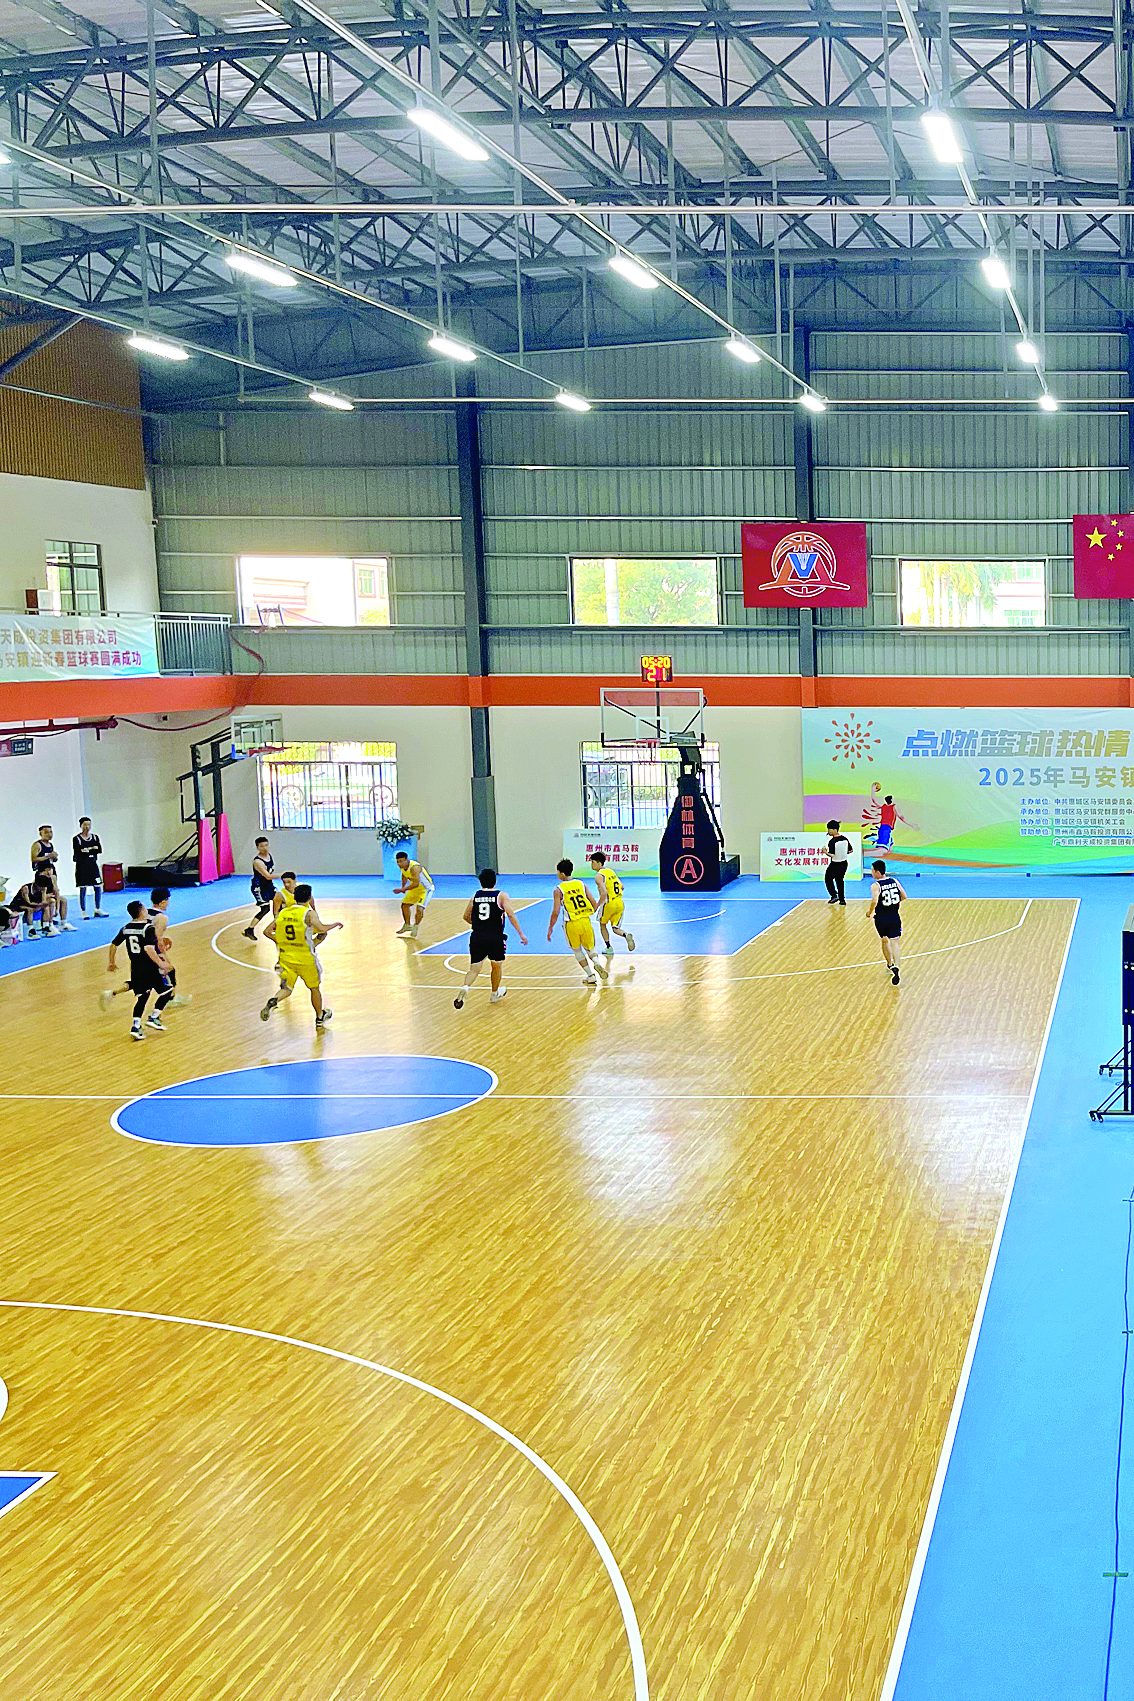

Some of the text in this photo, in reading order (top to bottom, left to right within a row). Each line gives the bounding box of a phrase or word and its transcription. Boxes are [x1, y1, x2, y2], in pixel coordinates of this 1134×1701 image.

[0, 650, 142, 668] 安镇迎新春篮球赛圆满成功
[642, 657, 671, 668] 05:20
[647, 667, 667, 682] 21
[901, 729, 1131, 758] 点燃篮球热情
[585, 844, 640, 853] 惠州市鑫马鞍
[780, 847, 828, 856] 惠州市御林
[585, 853, 640, 863] 投有限公司
[775, 857, 829, 866] 文化发展有限
[680, 858, 698, 879] A
[613, 881, 620, 895] 6
[569, 894, 587, 910] 16
[881, 887, 901, 907] 35
[478, 902, 490, 921] 9
[285, 924, 296, 941] 9
[128, 935, 141, 954] 6
